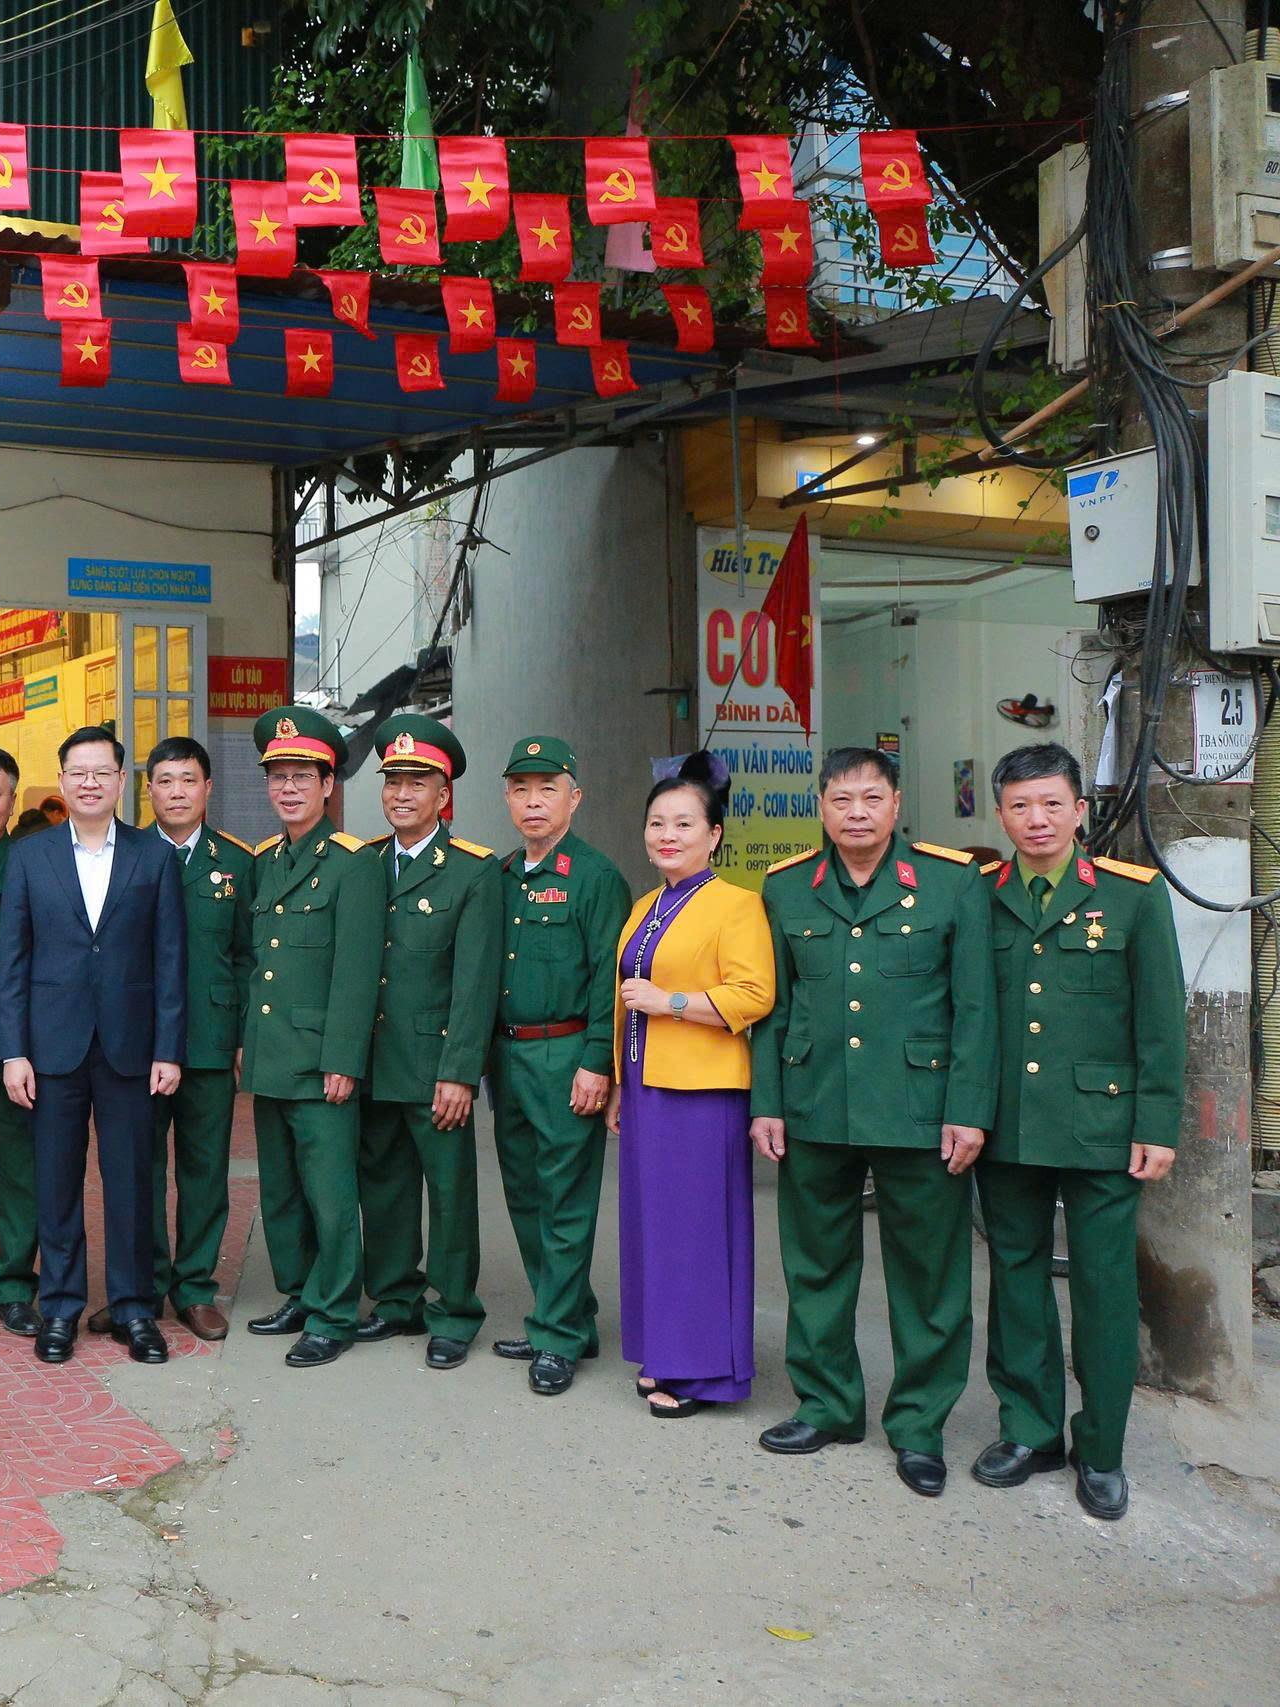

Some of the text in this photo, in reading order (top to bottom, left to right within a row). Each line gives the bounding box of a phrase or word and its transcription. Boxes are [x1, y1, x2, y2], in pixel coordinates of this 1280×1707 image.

[1080, 493, 1115, 508] VNPT
[231, 663, 262, 685] LỐI VÀO
[209, 690, 283, 710] KHU VỰC BỎ PHIẾU
[716, 700, 760, 722] BÌNH
[1221, 688, 1243, 726] 2.5
[1199, 734, 1217, 748] TBA
[1219, 731, 1239, 748] SÔNG
[743, 742, 768, 774] VĂN
[772, 744, 813, 774] PHÒNG
[733, 787, 755, 825] HỘP
[764, 793, 788, 817] CƠM
[791, 784, 819, 818] SUẤT
[746, 843, 769, 854] 0971
[773, 843, 791, 855] 908
